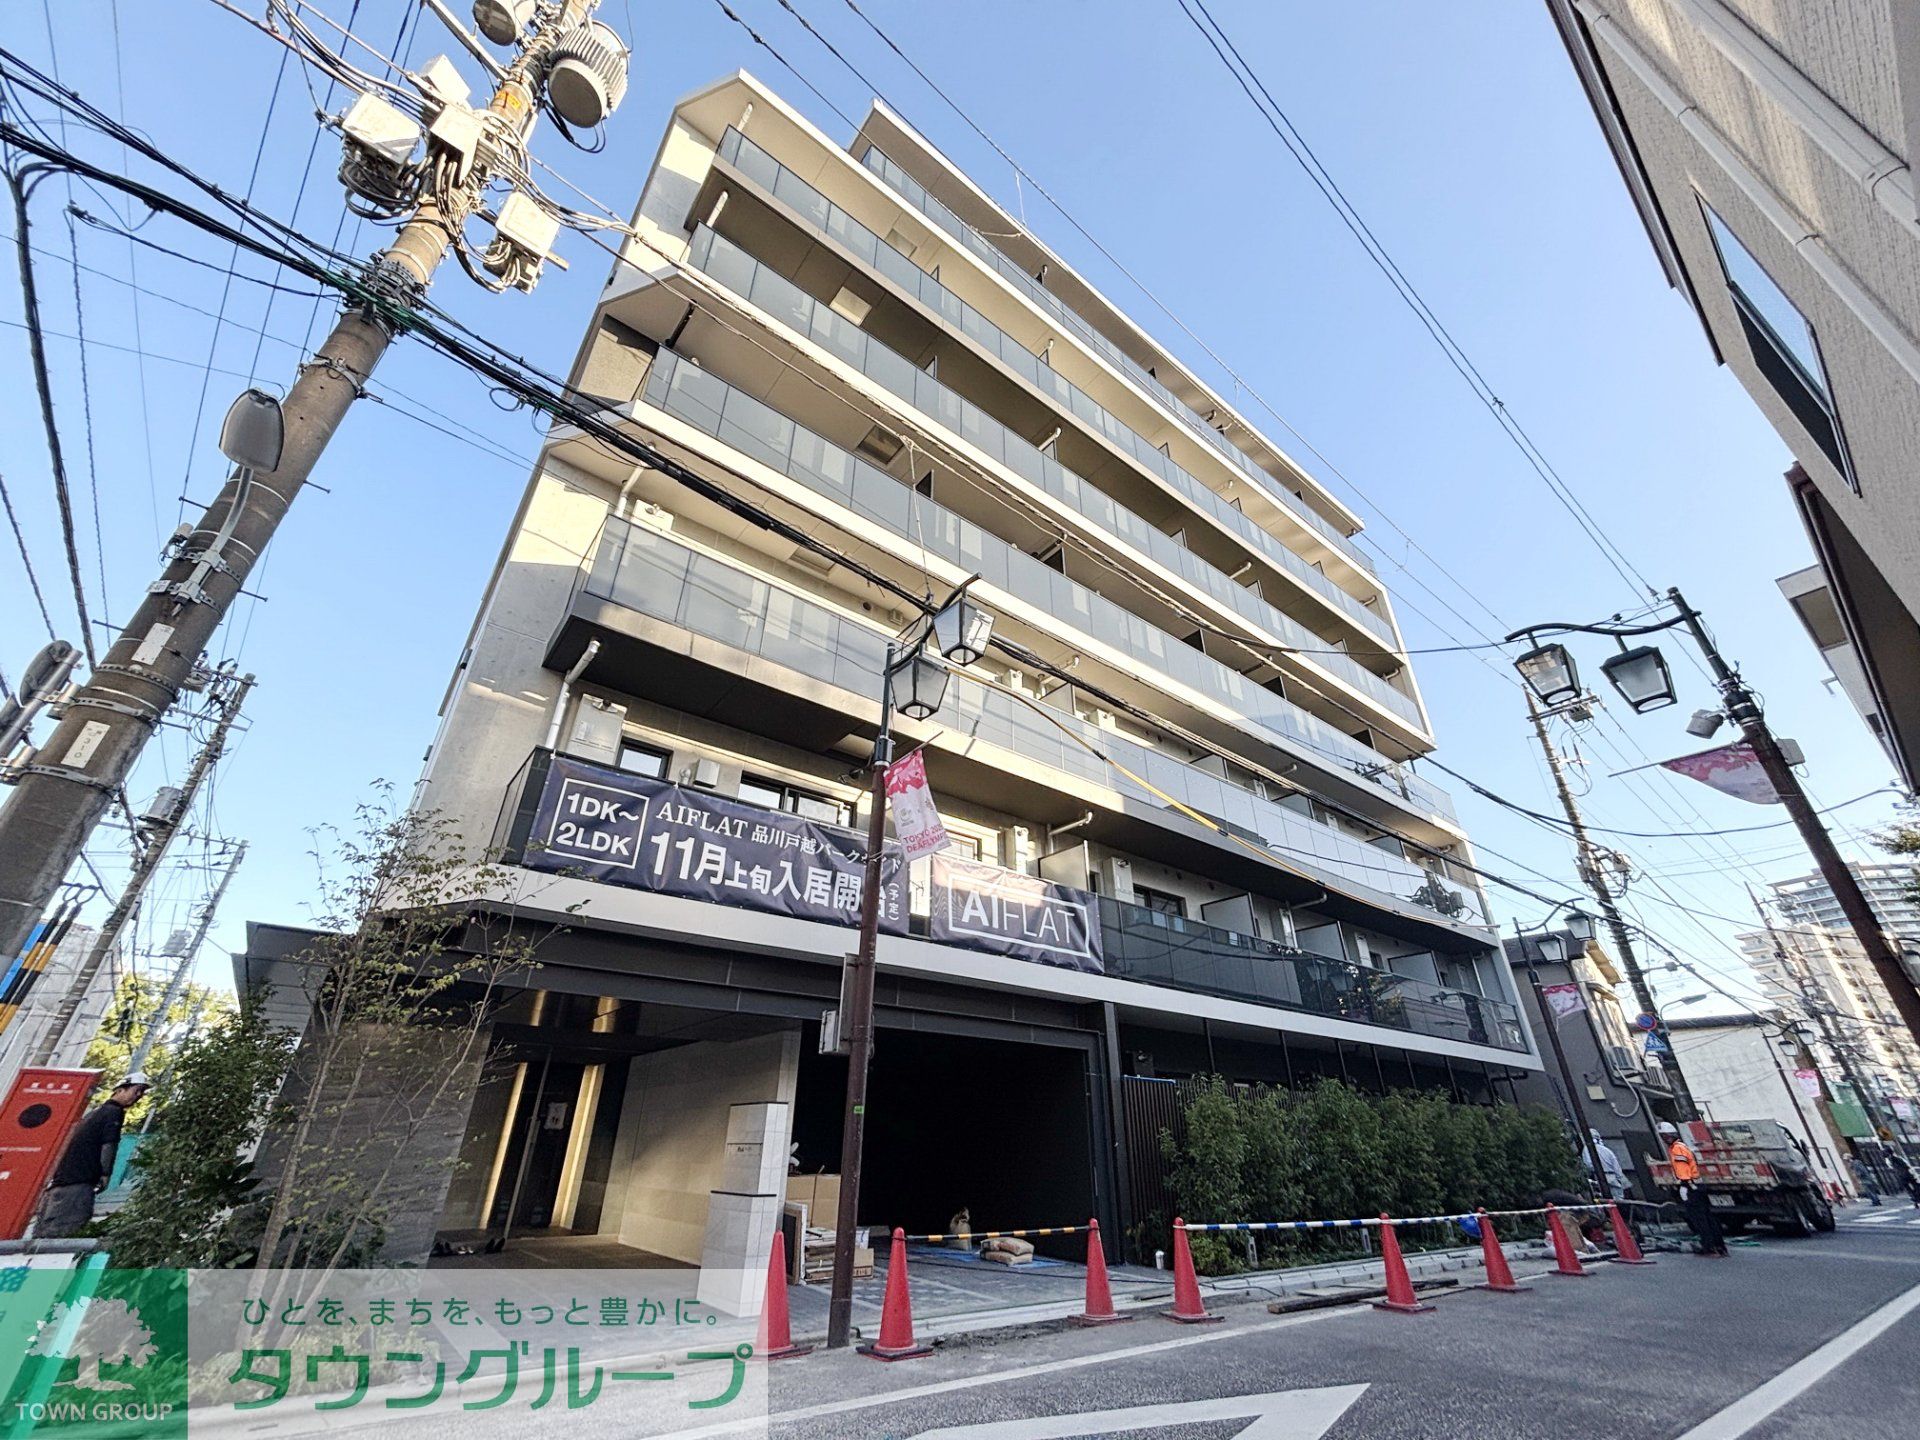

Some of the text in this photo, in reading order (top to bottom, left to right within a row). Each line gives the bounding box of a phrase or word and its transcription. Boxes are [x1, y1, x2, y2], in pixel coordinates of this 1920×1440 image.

[656, 802, 749, 839] AIFLAT
[903, 829, 930, 844] TOKYO
[556, 822, 633, 857] 2LDK
[961, 889, 1076, 944] AIFLAT
